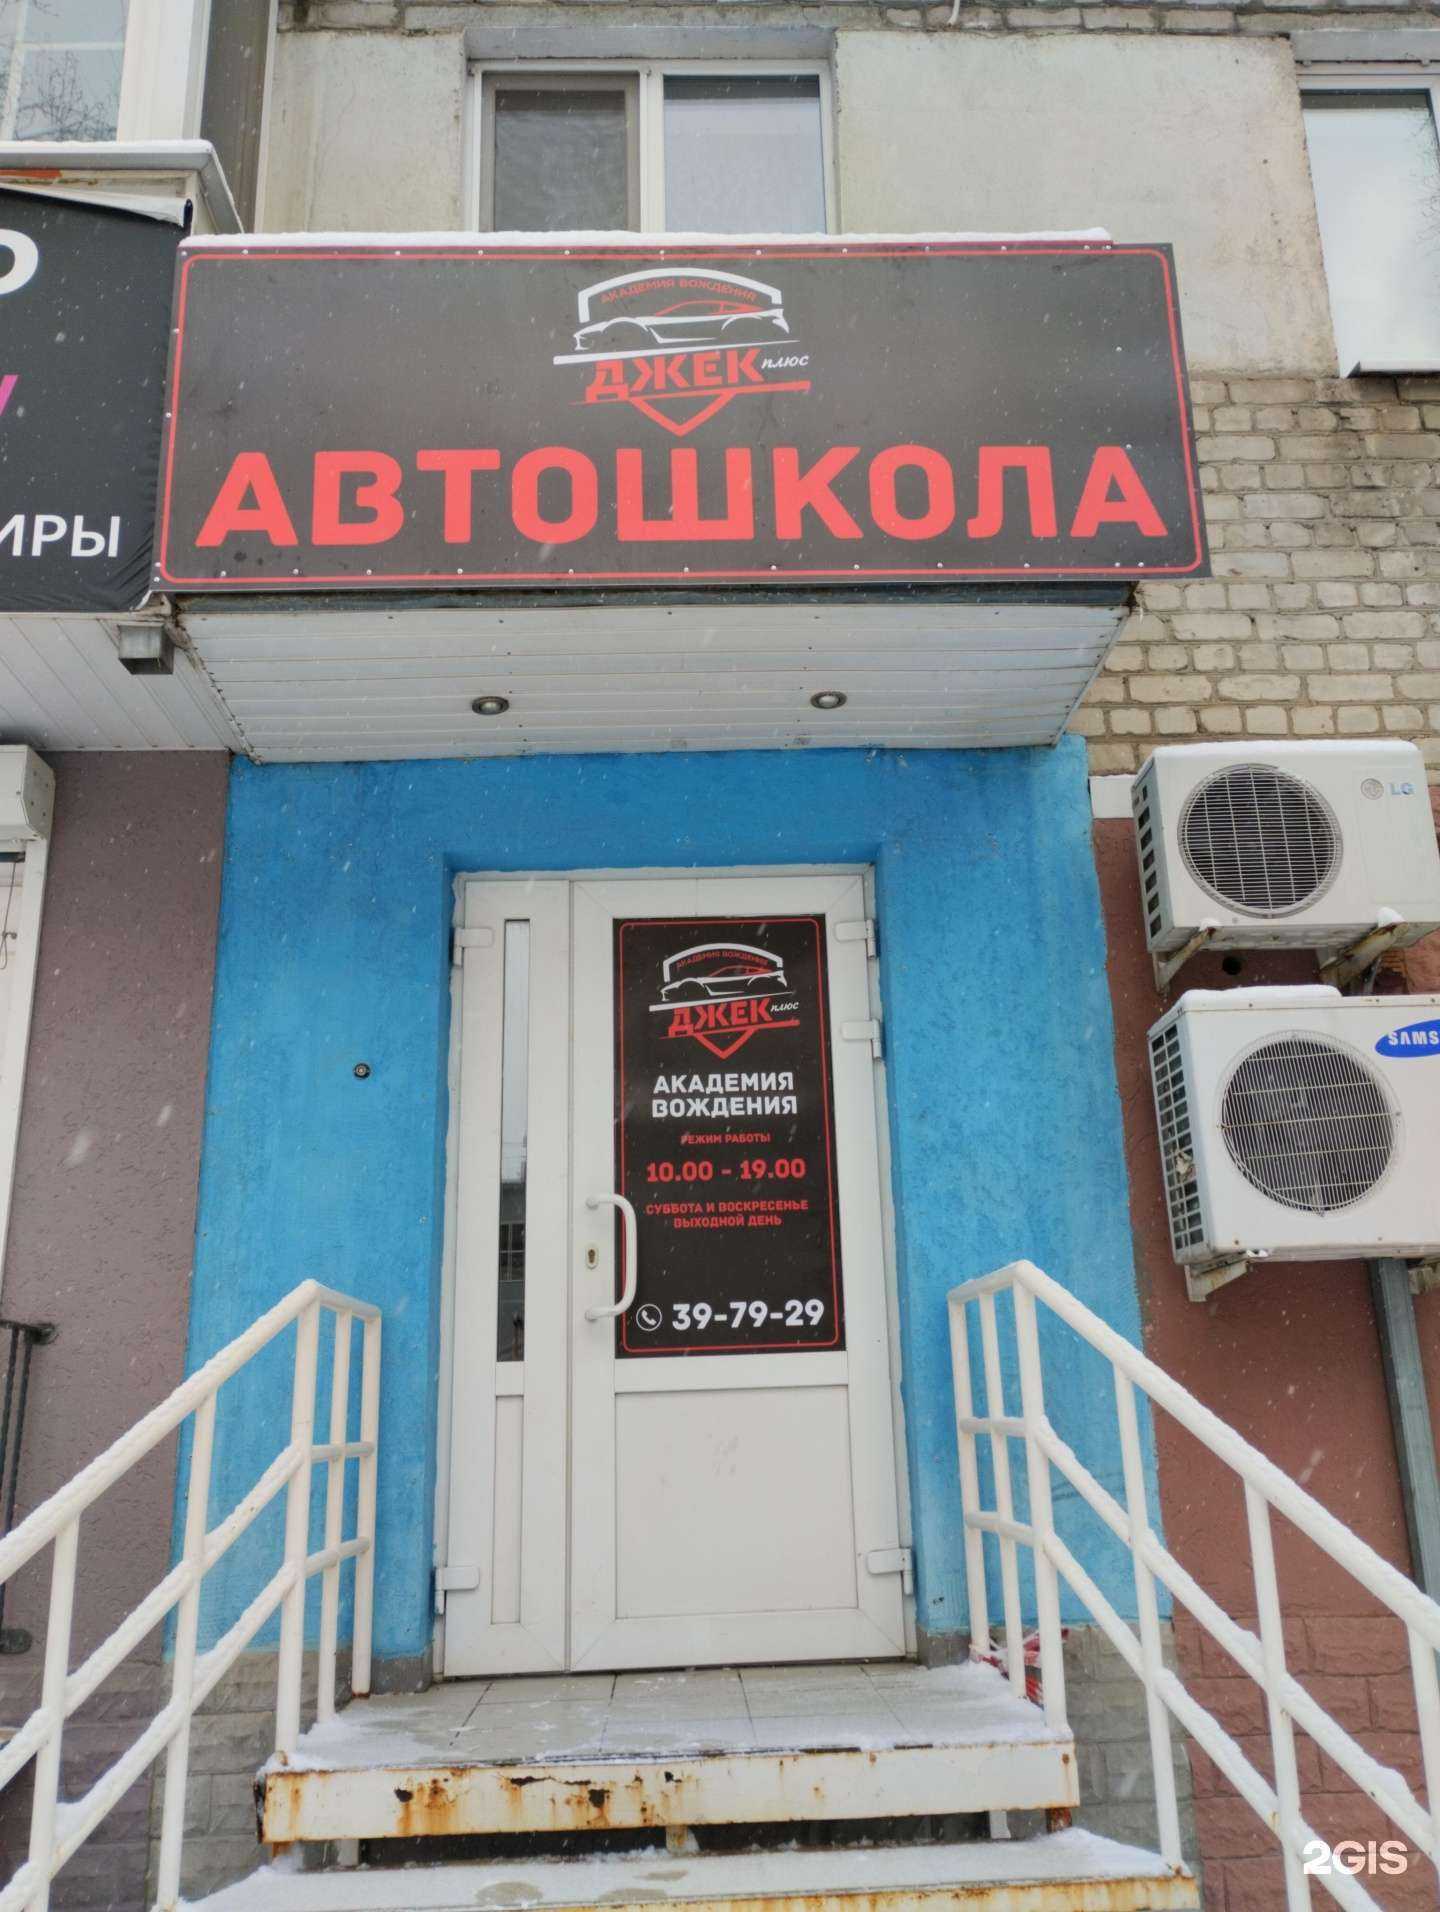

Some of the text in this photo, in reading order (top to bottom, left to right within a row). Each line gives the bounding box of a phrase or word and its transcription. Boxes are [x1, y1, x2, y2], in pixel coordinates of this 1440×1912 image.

[679, 278, 758, 302] ВОЖДЕНИЯ
[584, 348, 765, 403] ДЖЕК
[195, 444, 1169, 547] АВТОШКОЛА
[1388, 783, 1414, 796] LG
[668, 998, 773, 1038] ДЖЕК
[1388, 1030, 1440, 1046] SAMS
[653, 1072, 794, 1094] АКАДЕМИЯ
[652, 1096, 798, 1118] ВОЖДЕНИЯ
[680, 1133, 771, 1145] РЕЖИМ РАБОТЫ
[646, 1161, 713, 1182] 10.00
[740, 1158, 806, 1180] 19.00
[646, 1200, 809, 1215] СУББОТА И ВОСКРЕСЕНЬЕ
[674, 1214, 782, 1229] ВЫХОДНОЙ ДЕНЬ
[672, 1299, 825, 1331] 39-79-29
